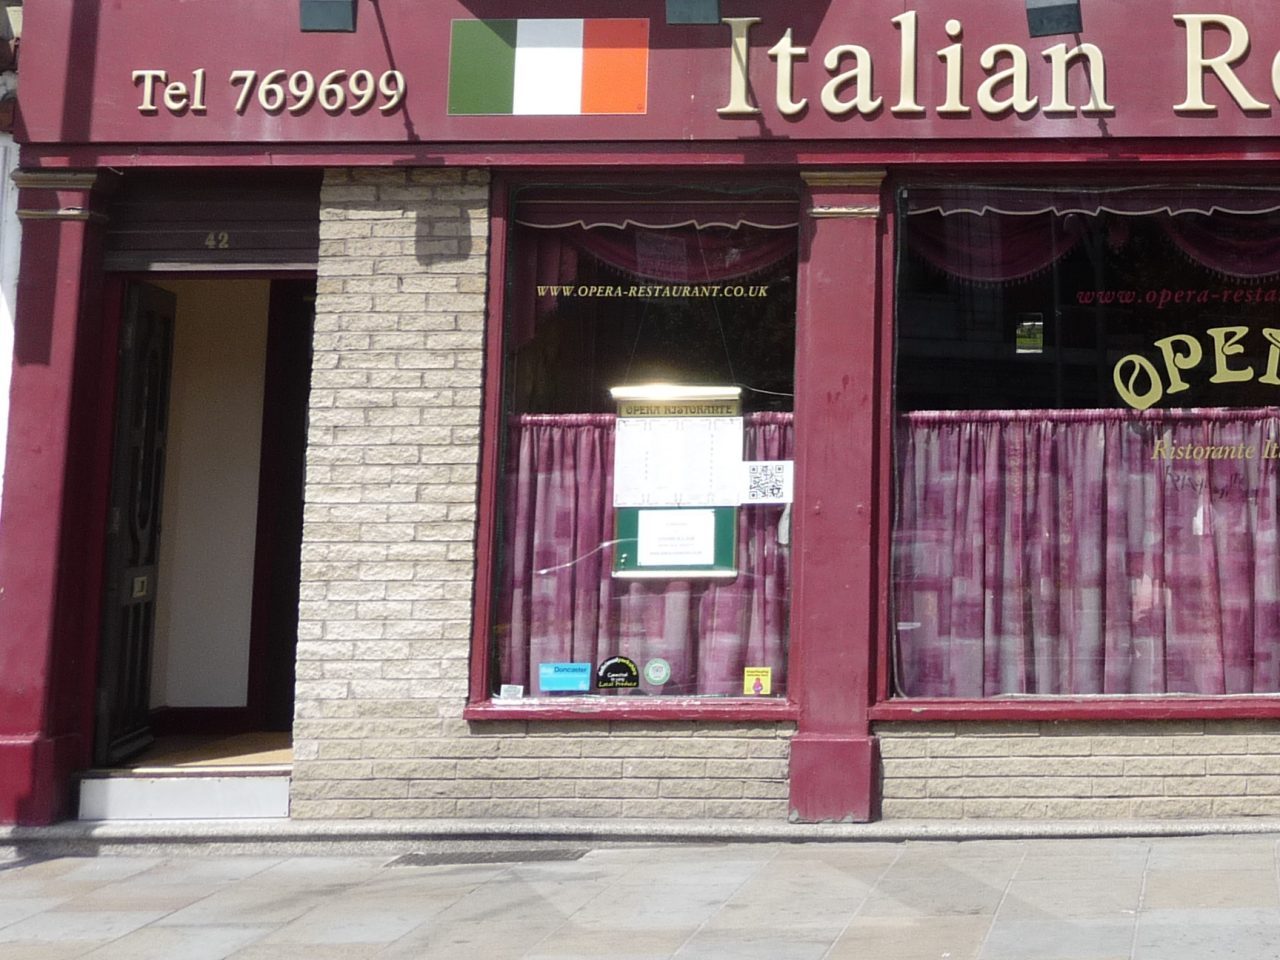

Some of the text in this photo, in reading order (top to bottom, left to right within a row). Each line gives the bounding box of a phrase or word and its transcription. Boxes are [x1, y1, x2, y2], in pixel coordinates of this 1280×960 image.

[716, 10, 1116, 116] Italian
[132, 68, 406, 112] Tel 769699
[205, 231, 230, 248] 42
[536, 285, 769, 298] WWW.OPERA-RESTAURANT.CO.UK
[1151, 440, 1255, 460] Ristorante
